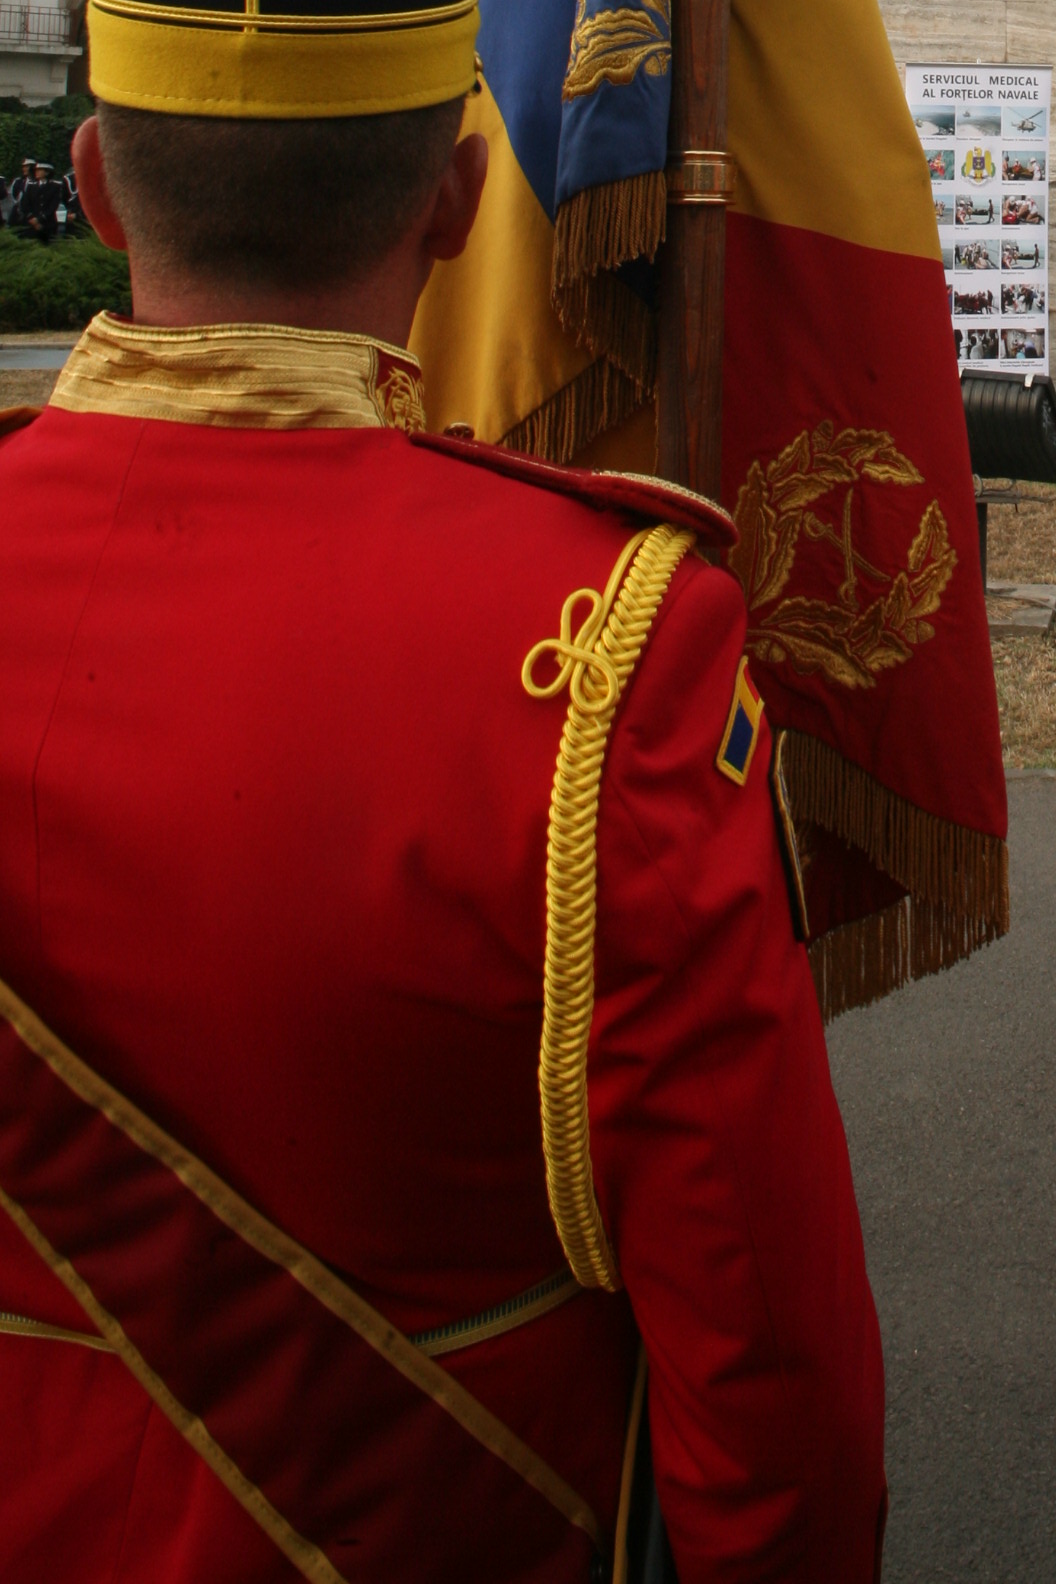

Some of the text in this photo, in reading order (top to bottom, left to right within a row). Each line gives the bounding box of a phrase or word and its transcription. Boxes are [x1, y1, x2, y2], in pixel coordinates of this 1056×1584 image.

[922, 74, 1039, 86] SERVICIUL MEDICAL
[922, 88, 936, 98] AL
[998, 90, 1039, 100] NAVALE
